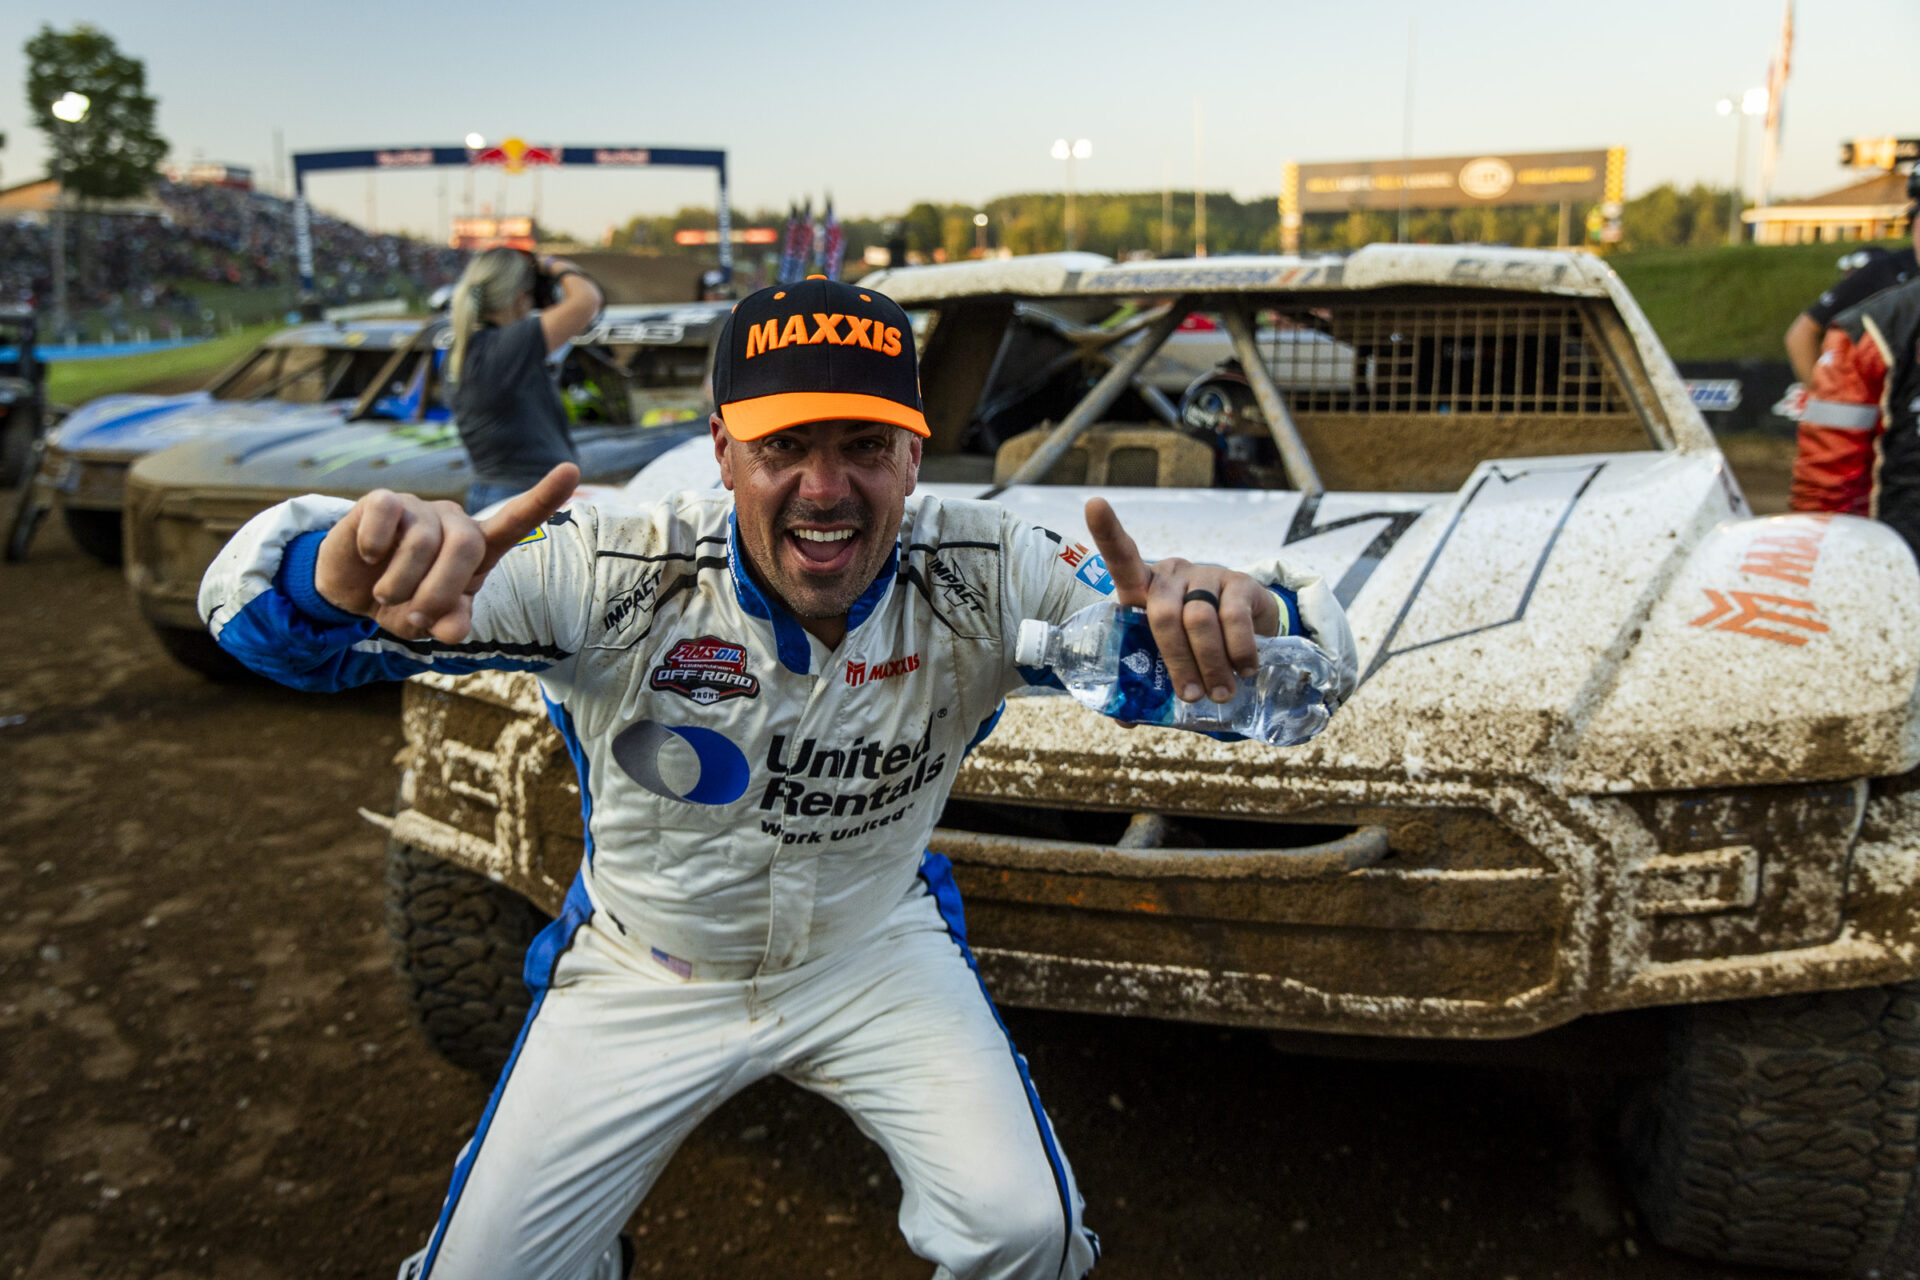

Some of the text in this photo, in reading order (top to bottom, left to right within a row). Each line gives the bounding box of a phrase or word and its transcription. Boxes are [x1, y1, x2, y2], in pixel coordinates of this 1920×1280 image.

[746, 313, 902, 359] MAXXIS
[604, 569, 661, 630] IMPACT
[928, 558, 985, 613] IMPACT
[671, 645, 741, 661] AMSOIL
[868, 652, 920, 681] MAXXIS
[657, 669, 753, 688] OFF-ROAD
[766, 711, 933, 780] United
[759, 752, 946, 817] Rentals
[762, 806, 906, 845] Work United
